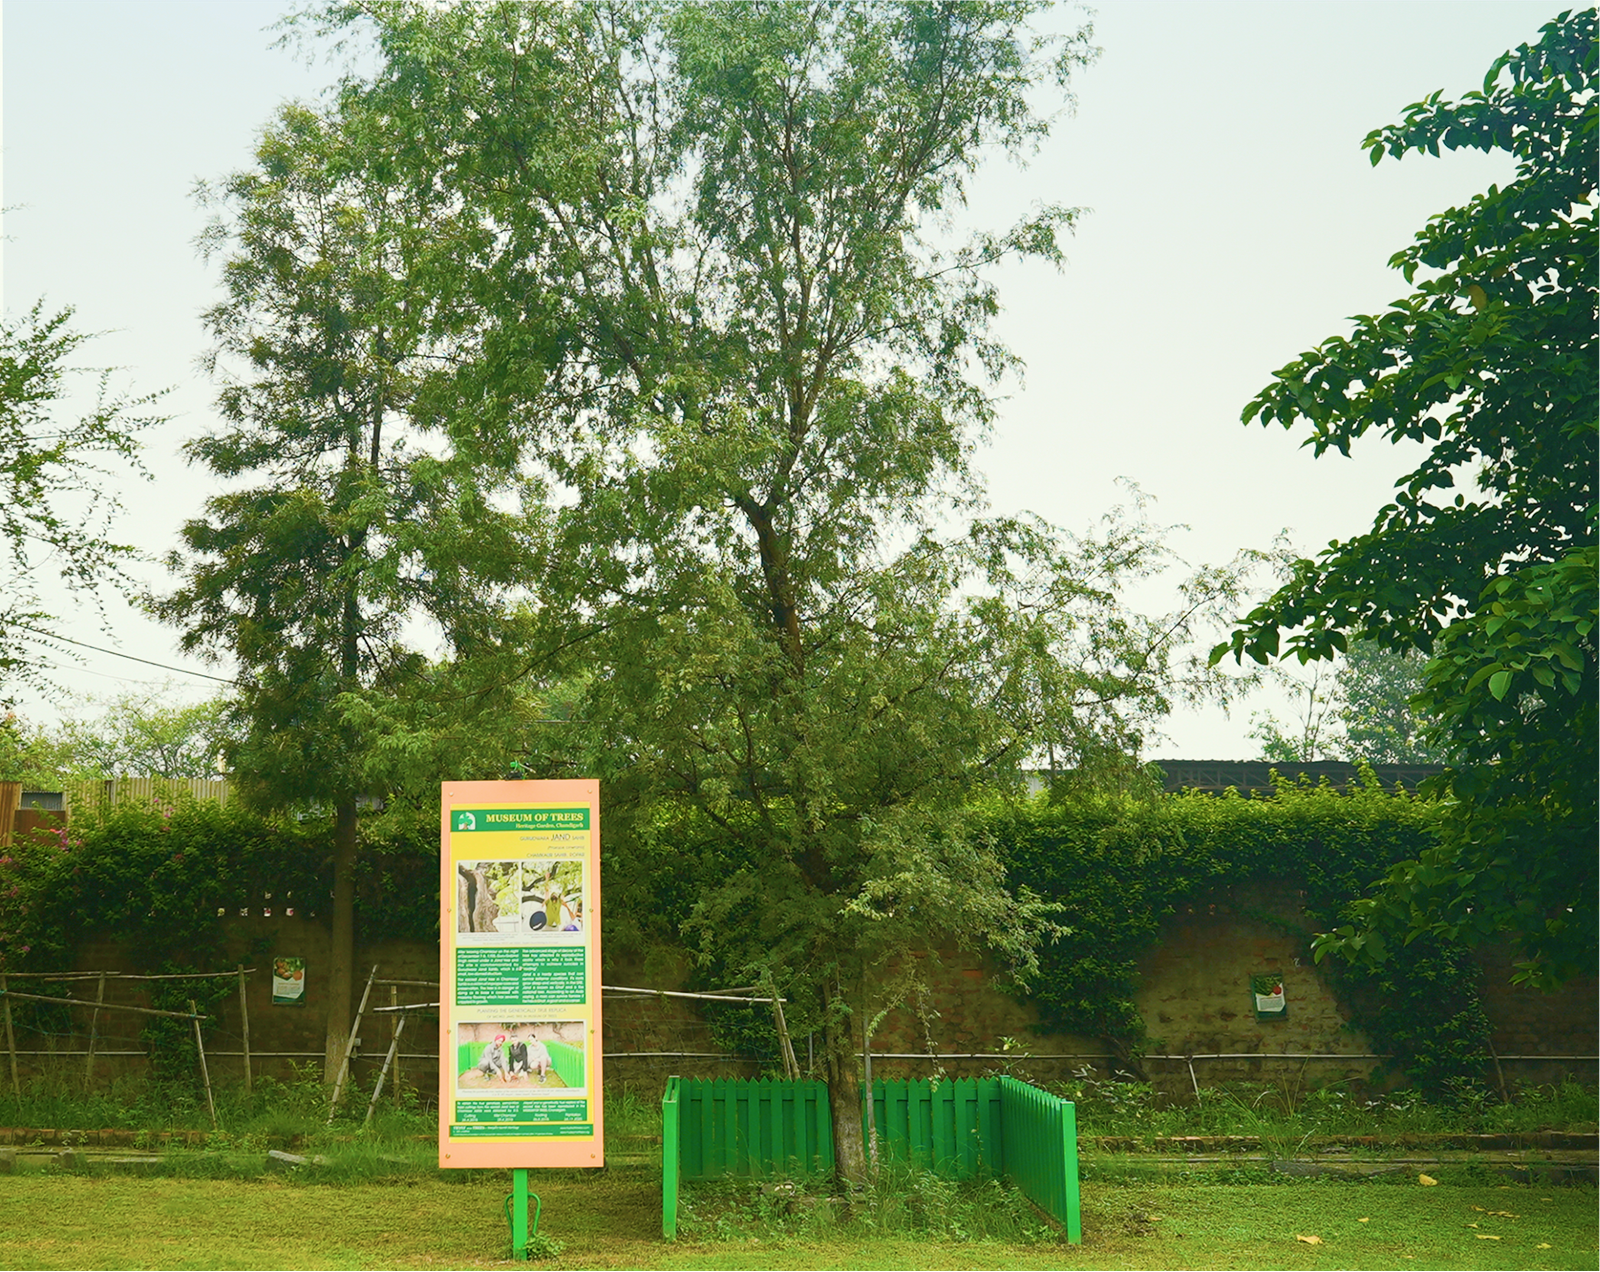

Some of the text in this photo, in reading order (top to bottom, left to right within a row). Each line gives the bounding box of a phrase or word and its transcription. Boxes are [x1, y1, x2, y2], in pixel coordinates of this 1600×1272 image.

[486, 812, 584, 823] MUSEUM OF TREES
[551, 833, 571, 841] JAND
